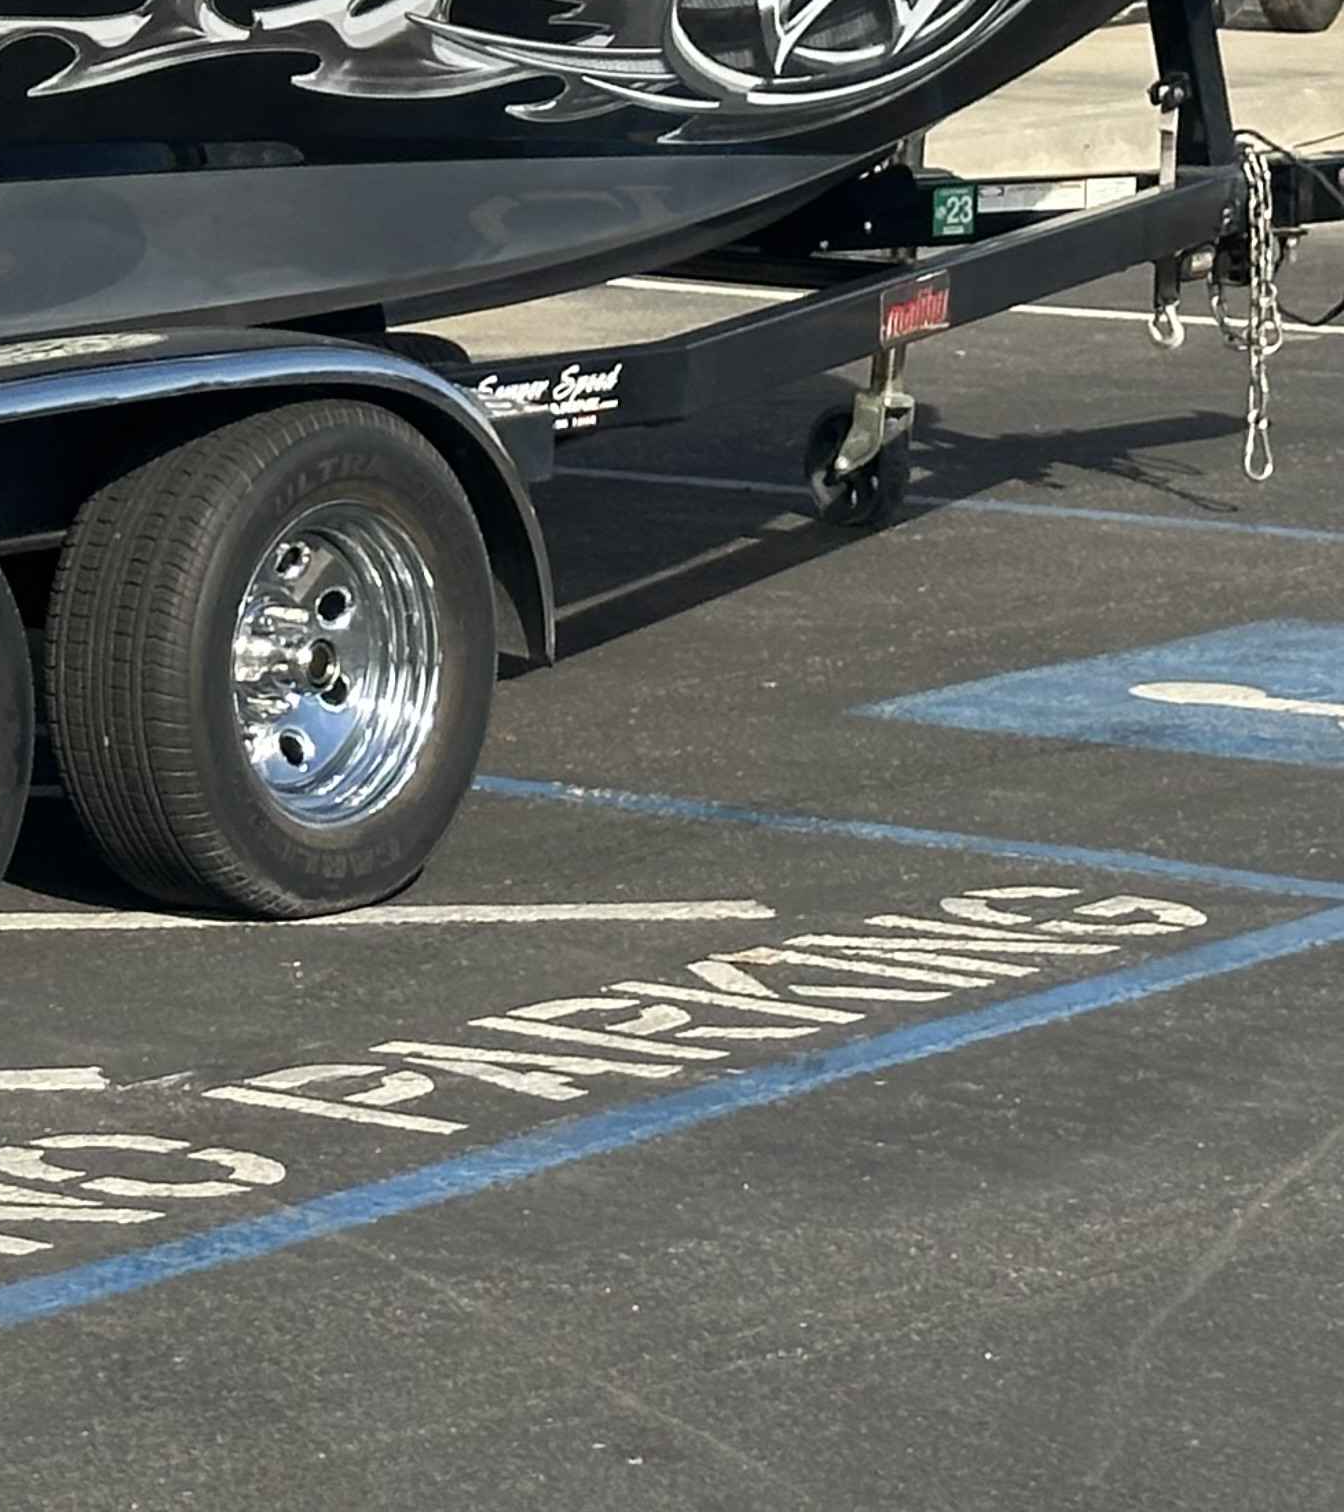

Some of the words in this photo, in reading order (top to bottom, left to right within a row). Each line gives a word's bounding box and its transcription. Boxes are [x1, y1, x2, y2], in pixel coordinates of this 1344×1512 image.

[946, 195, 973, 224] 23
[552, 362, 622, 402] Speed
[202, 885, 1209, 1136] PARKING
